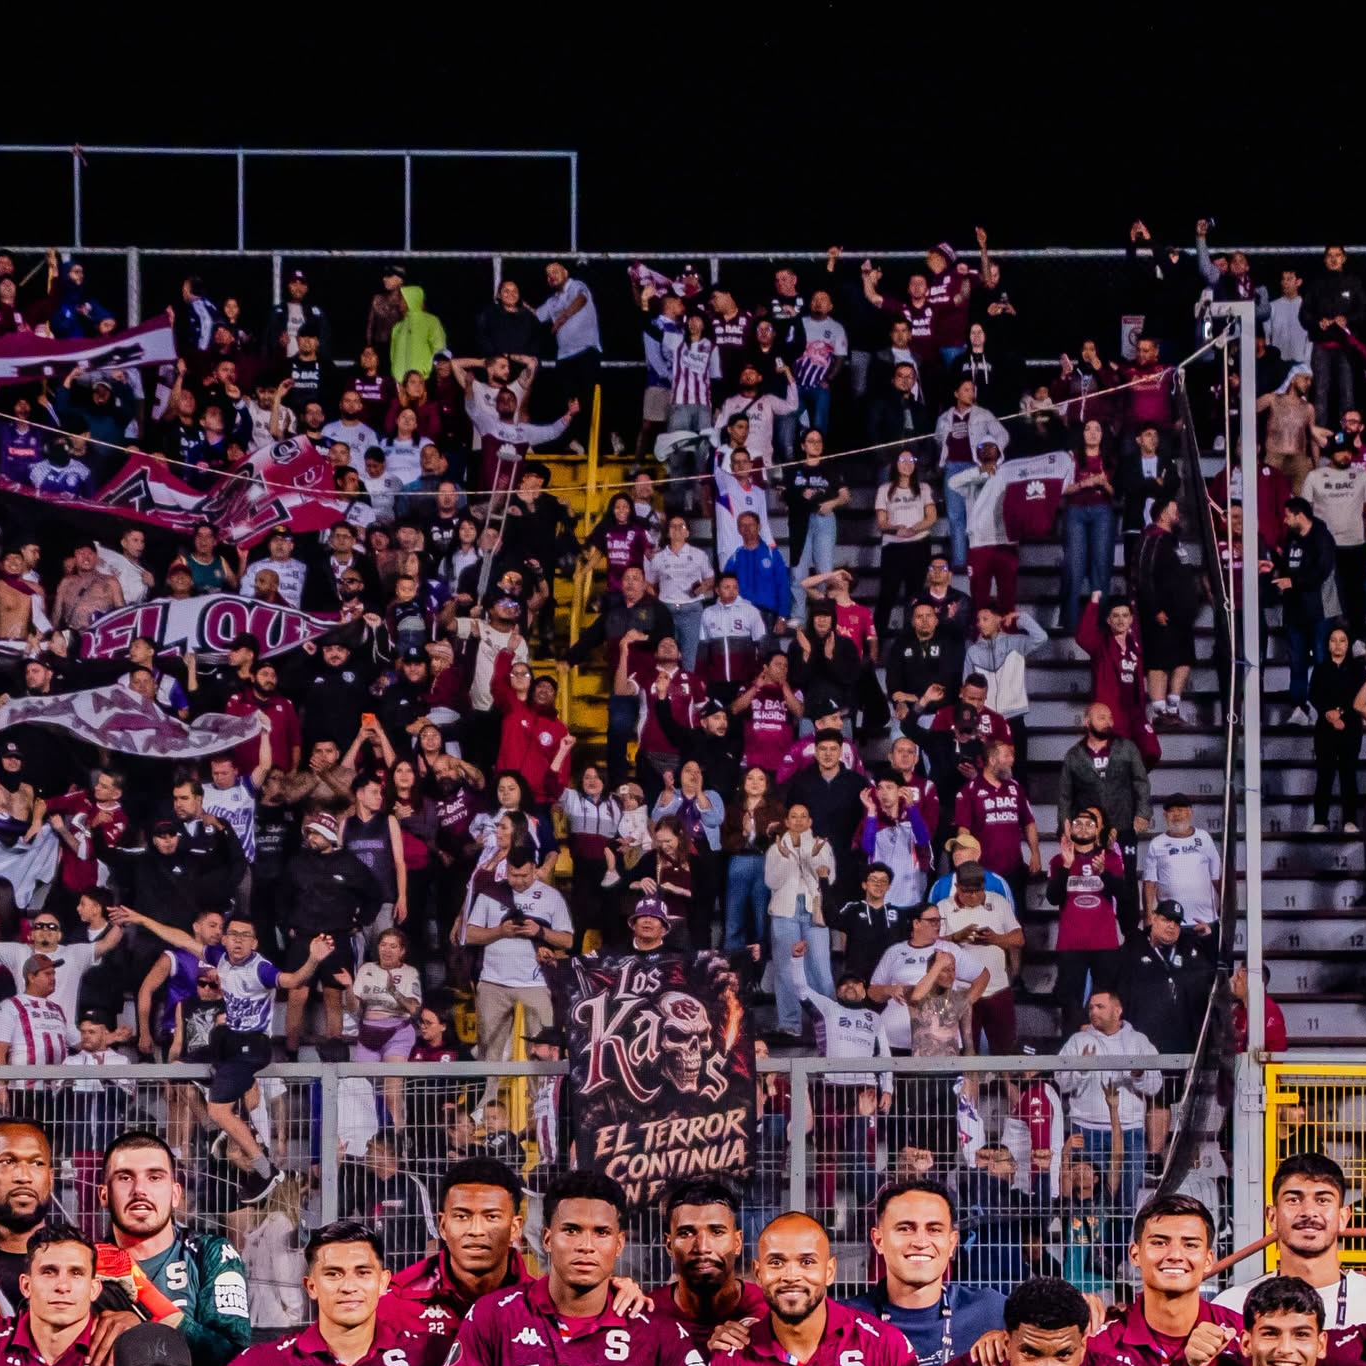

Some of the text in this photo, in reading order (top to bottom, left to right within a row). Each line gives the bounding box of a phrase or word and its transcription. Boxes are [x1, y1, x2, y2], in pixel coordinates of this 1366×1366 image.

[996, 798, 1017, 808] BAC
[1350, 935, 1364, 946] 12
[595, 1107, 749, 1160] EL TERROR
[604, 1139, 746, 1182] CONTINUA
[166, 1260, 187, 1291] S
[428, 1322, 445, 1335] 22
[604, 1329, 631, 1361] S
